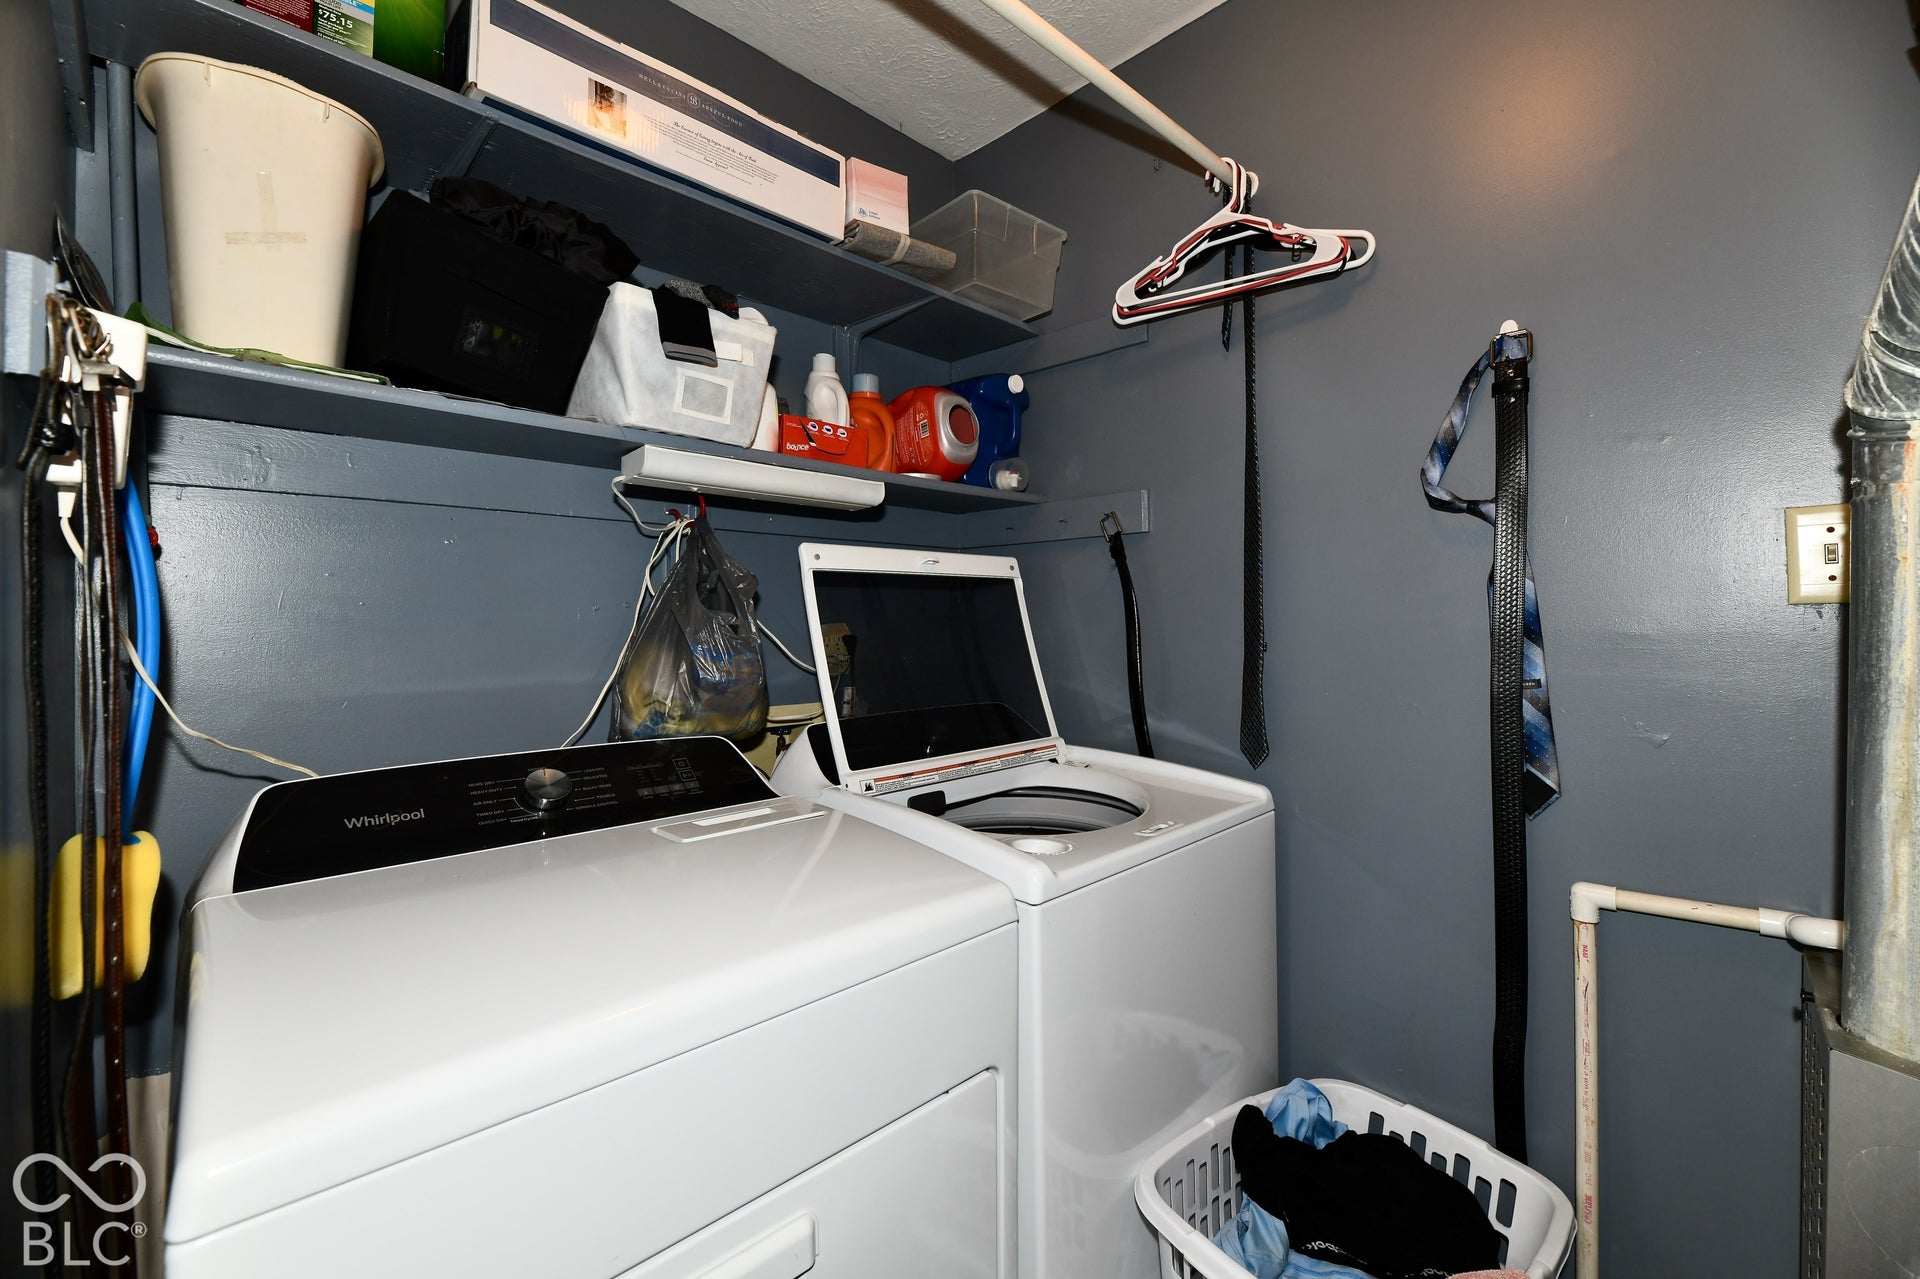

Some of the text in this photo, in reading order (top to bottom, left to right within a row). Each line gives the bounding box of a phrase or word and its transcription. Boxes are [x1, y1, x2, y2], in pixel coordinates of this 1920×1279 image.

[318, 9, 353, 29] $75.15
[786, 442, 810, 452] bounce
[343, 808, 425, 829] Whirlpool
